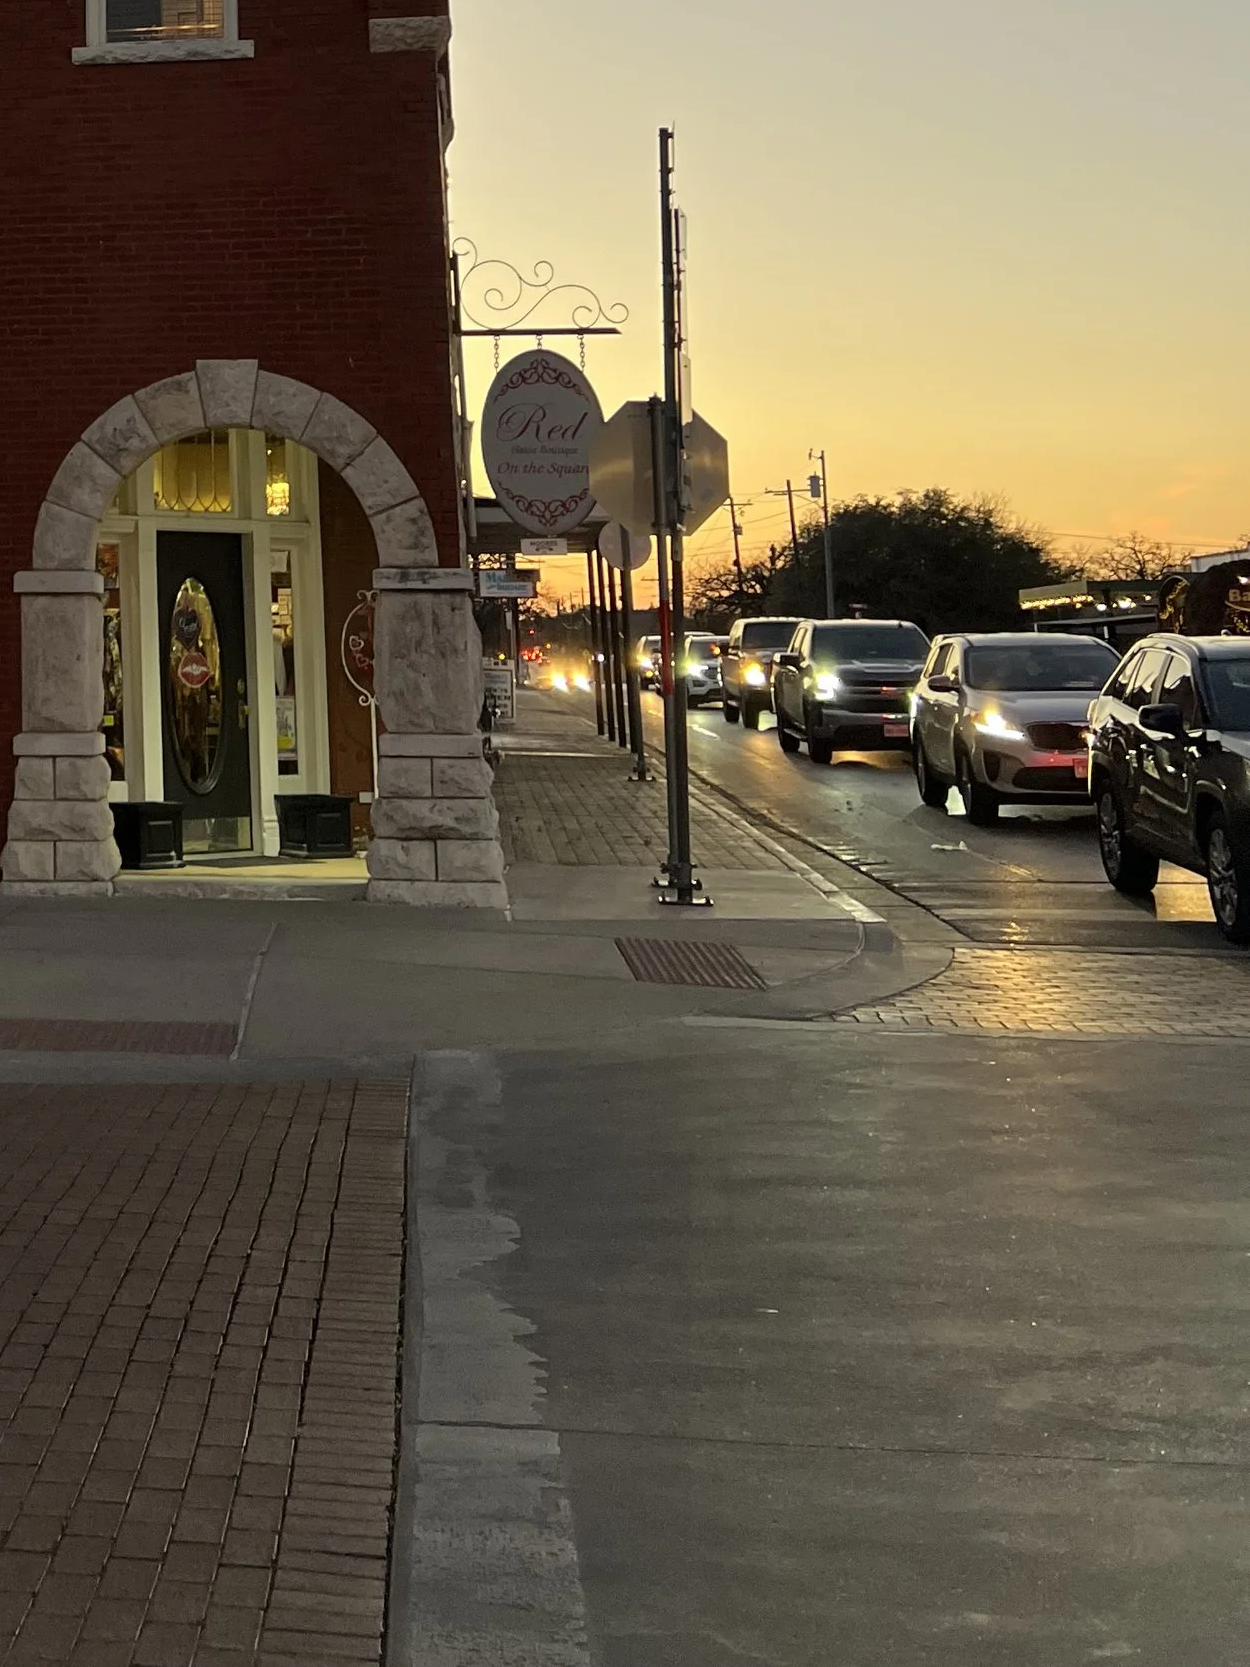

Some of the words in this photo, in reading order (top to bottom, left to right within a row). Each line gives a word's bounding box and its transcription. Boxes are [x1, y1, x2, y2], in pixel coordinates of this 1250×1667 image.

[497, 402, 588, 442] Red
[498, 462, 518, 474] On
[523, 460, 545, 474] the
[547, 462, 589, 478] Squar
